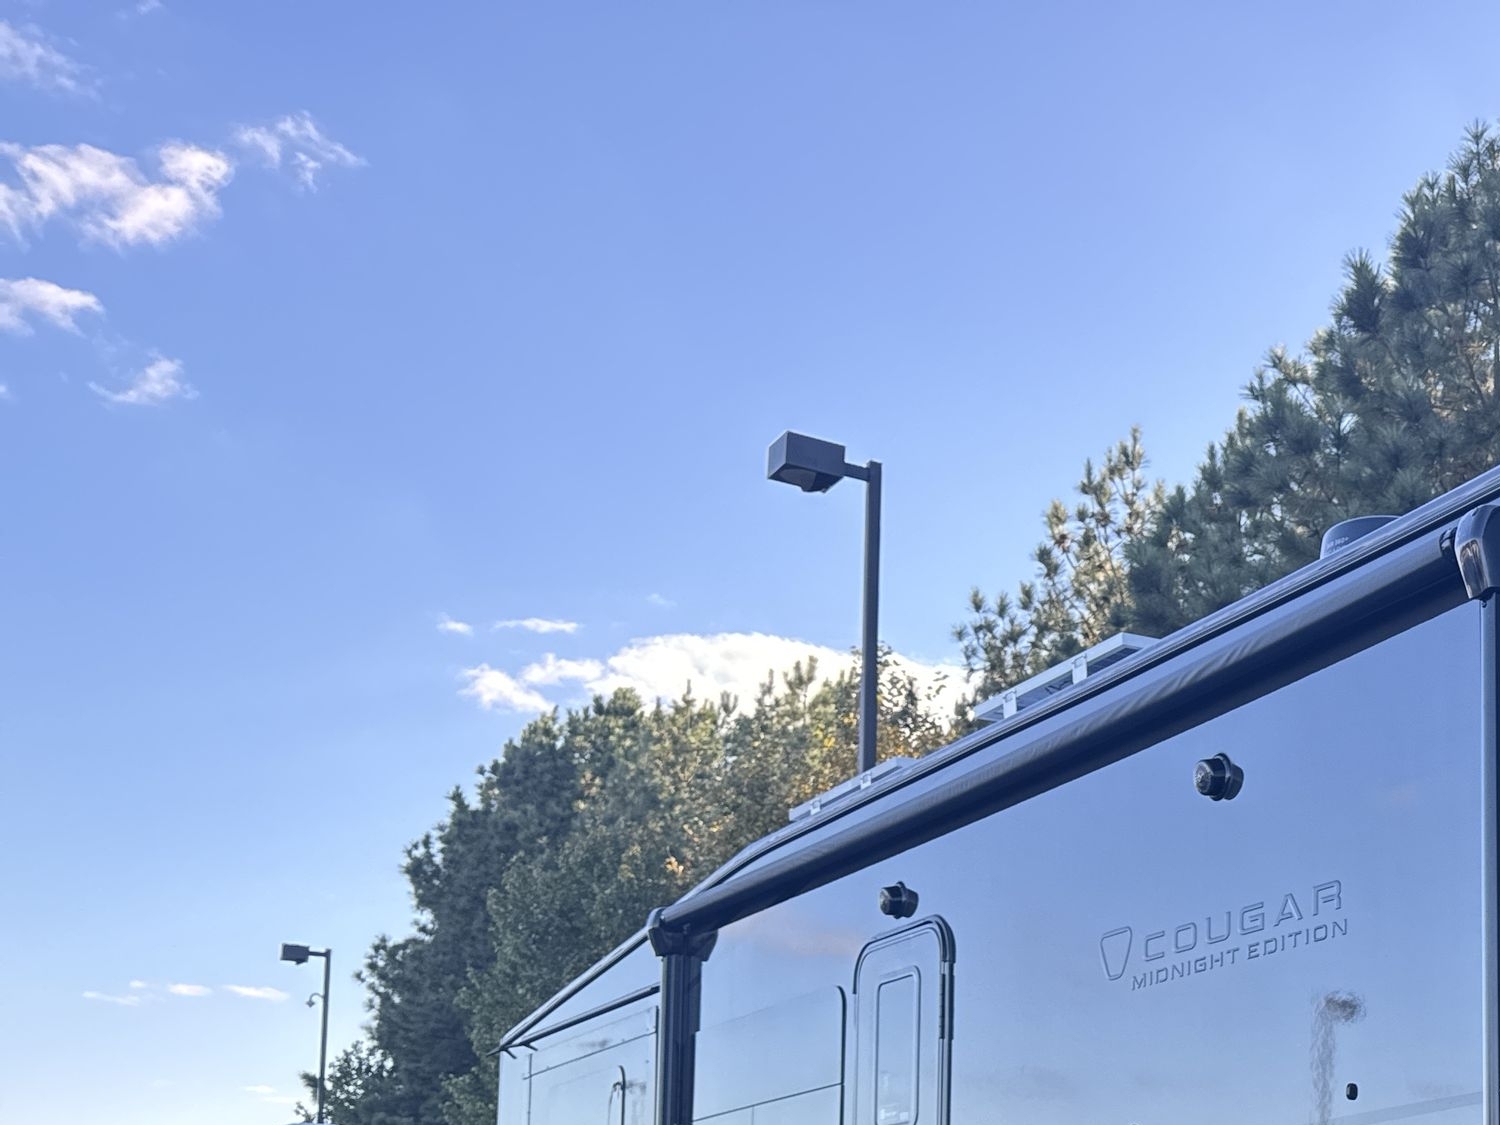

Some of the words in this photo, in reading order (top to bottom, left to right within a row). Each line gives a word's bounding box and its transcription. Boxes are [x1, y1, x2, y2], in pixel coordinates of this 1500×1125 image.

[1131, 948, 1240, 991] MIDNIGHT
[1246, 918, 1348, 960] EDITION
[1143, 880, 1342, 962] COUGAR
